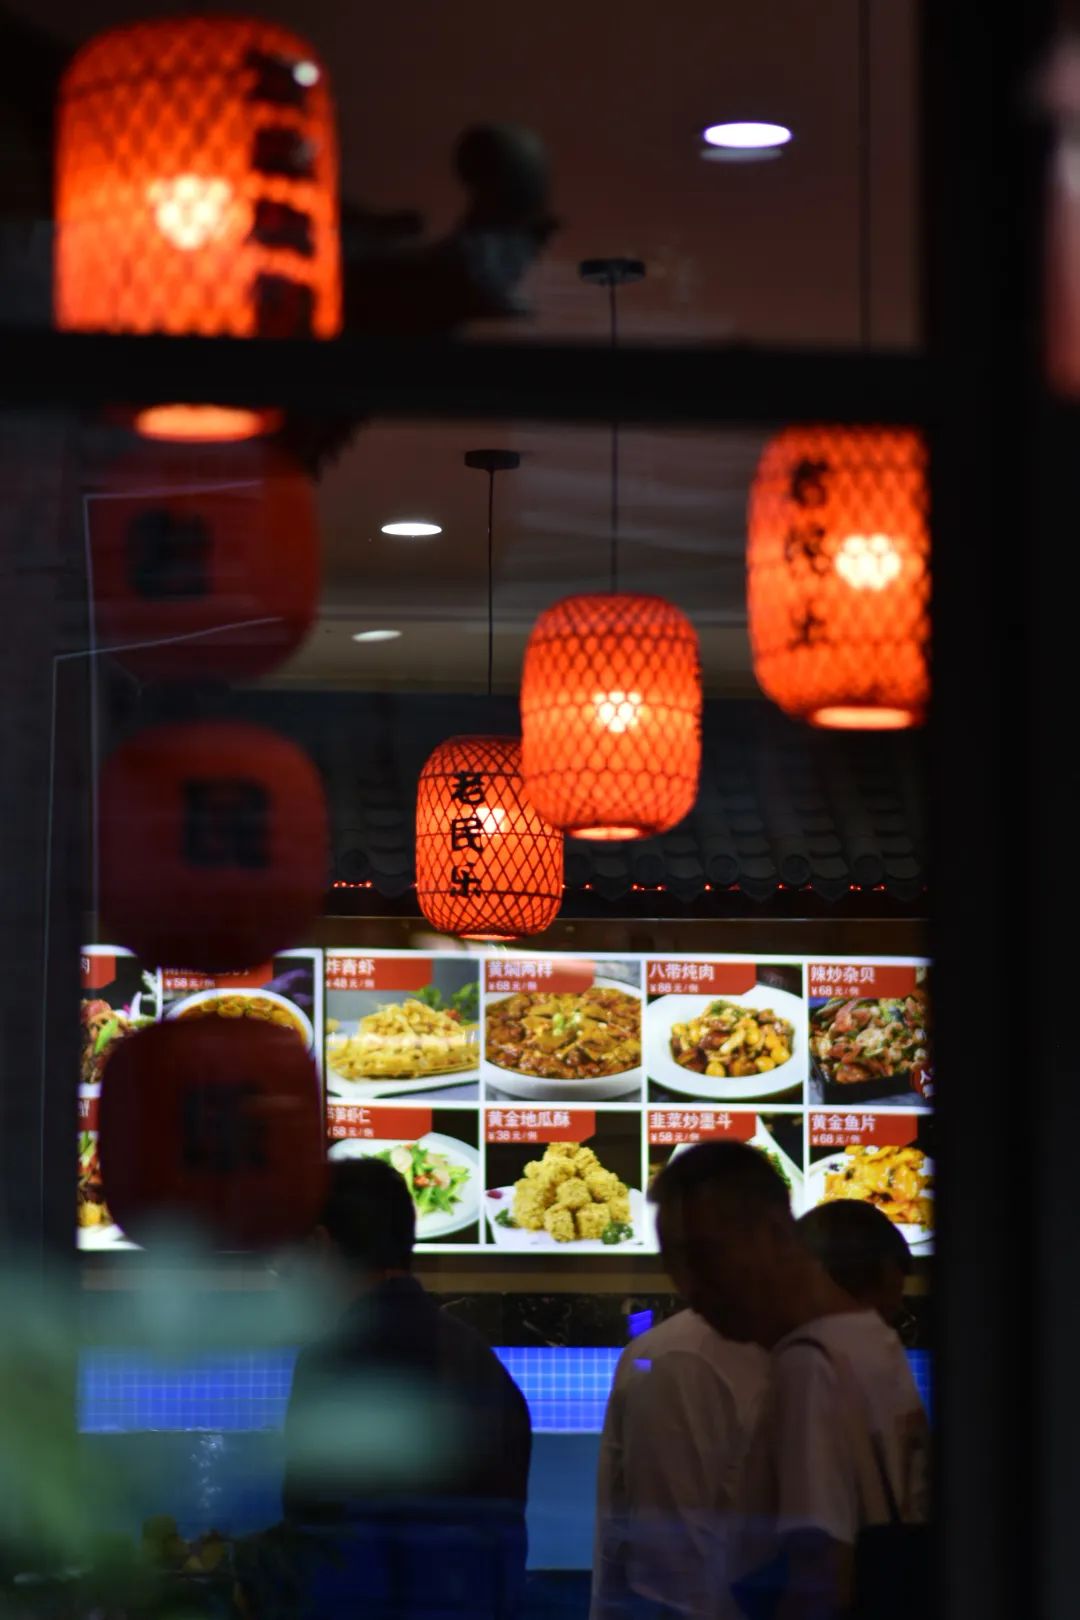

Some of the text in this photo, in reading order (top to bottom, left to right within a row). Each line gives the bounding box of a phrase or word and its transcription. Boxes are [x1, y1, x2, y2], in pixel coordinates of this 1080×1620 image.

[649, 963, 715, 981] 八带炖肉
[811, 966, 876, 983] 辣炒杂贝
[487, 1110, 571, 1128] 黄金地瓜酥
[650, 1112, 733, 1130] 韭菜炒墨斗
[811, 1114, 876, 1132] 黄金鱼片
